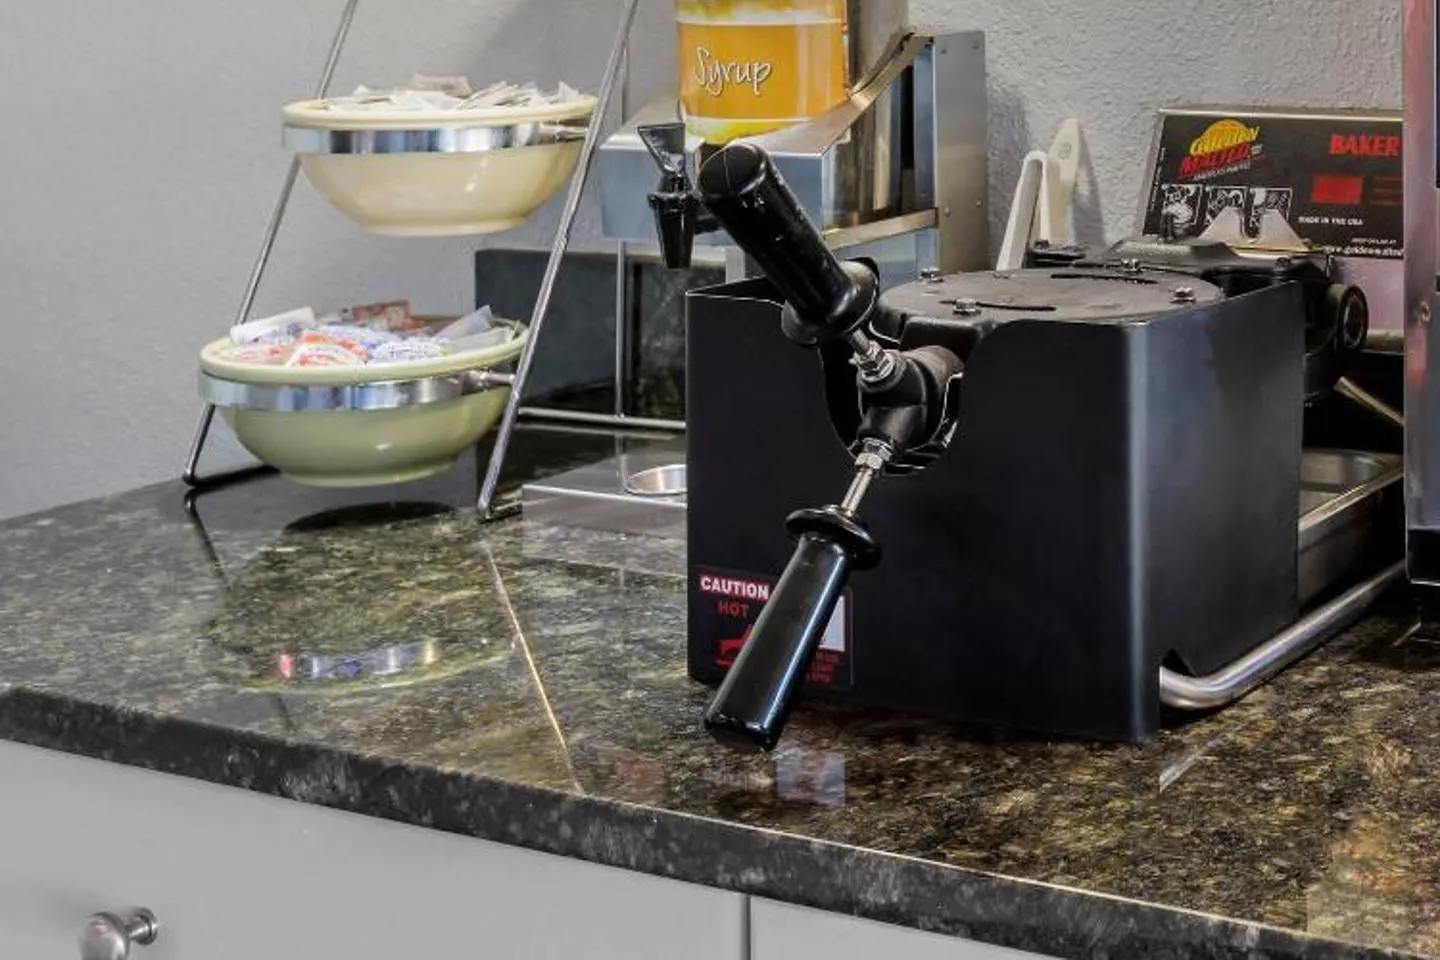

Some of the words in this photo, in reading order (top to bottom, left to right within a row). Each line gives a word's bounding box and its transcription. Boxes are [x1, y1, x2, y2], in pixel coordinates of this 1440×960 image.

[692, 46, 773, 98] Syrup
[1330, 134, 1400, 156] BAKER
[701, 577, 770, 599] CAUTION
[719, 601, 749, 617] HOT
